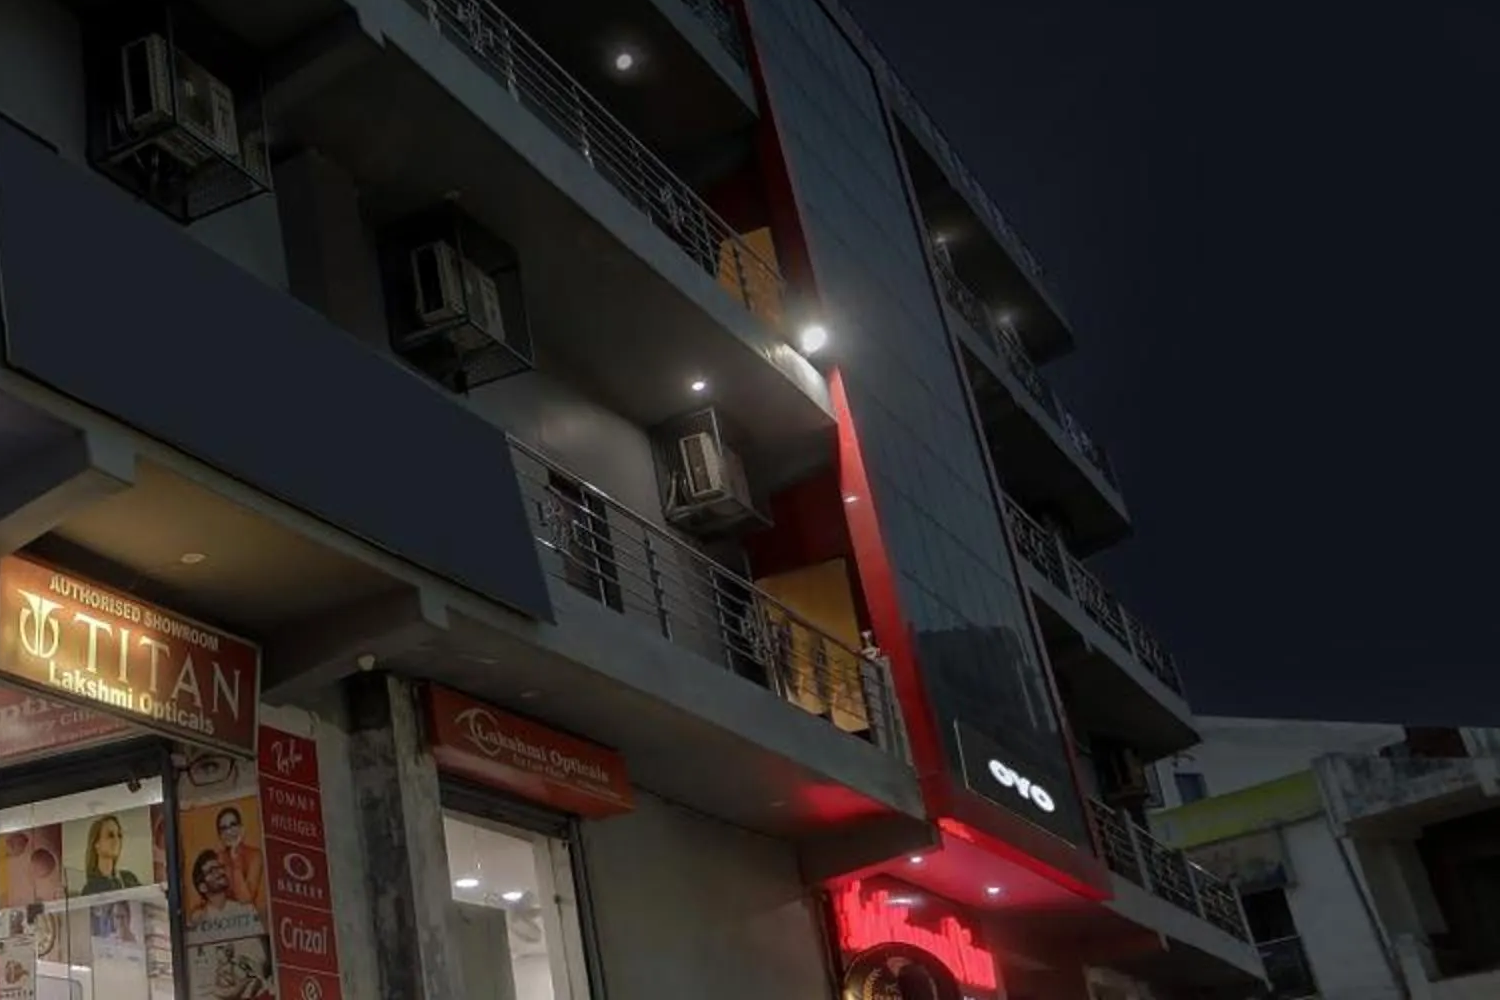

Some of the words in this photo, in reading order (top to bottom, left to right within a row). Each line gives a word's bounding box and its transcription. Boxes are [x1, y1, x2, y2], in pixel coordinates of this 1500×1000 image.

[49, 573, 141, 624] AUTHORISED
[143, 611, 219, 651] SHOWROOM
[49, 660, 133, 710] Lakshmi
[139, 693, 215, 736] Opticals
[74, 610, 241, 722] TITAN
[267, 786, 316, 812] TOMMY
[988, 759, 1055, 812] OYO
[280, 917, 329, 956] Crizal
